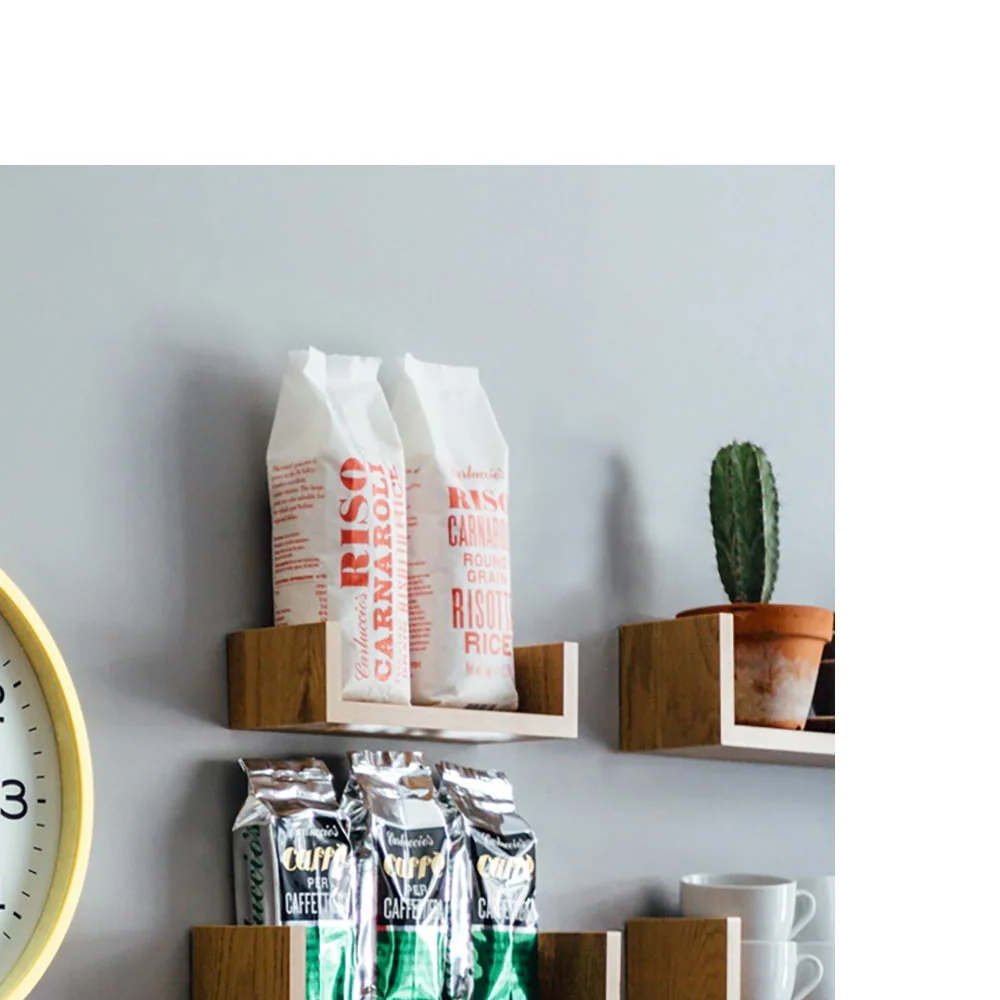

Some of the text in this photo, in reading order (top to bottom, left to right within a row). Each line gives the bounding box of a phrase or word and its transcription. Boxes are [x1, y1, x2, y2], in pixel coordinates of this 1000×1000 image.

[339, 456, 370, 589] RISO
[368, 462, 393, 682] CARNAROLI
[464, 631, 512, 656] RICE
[0, 779, 28, 820] 3
